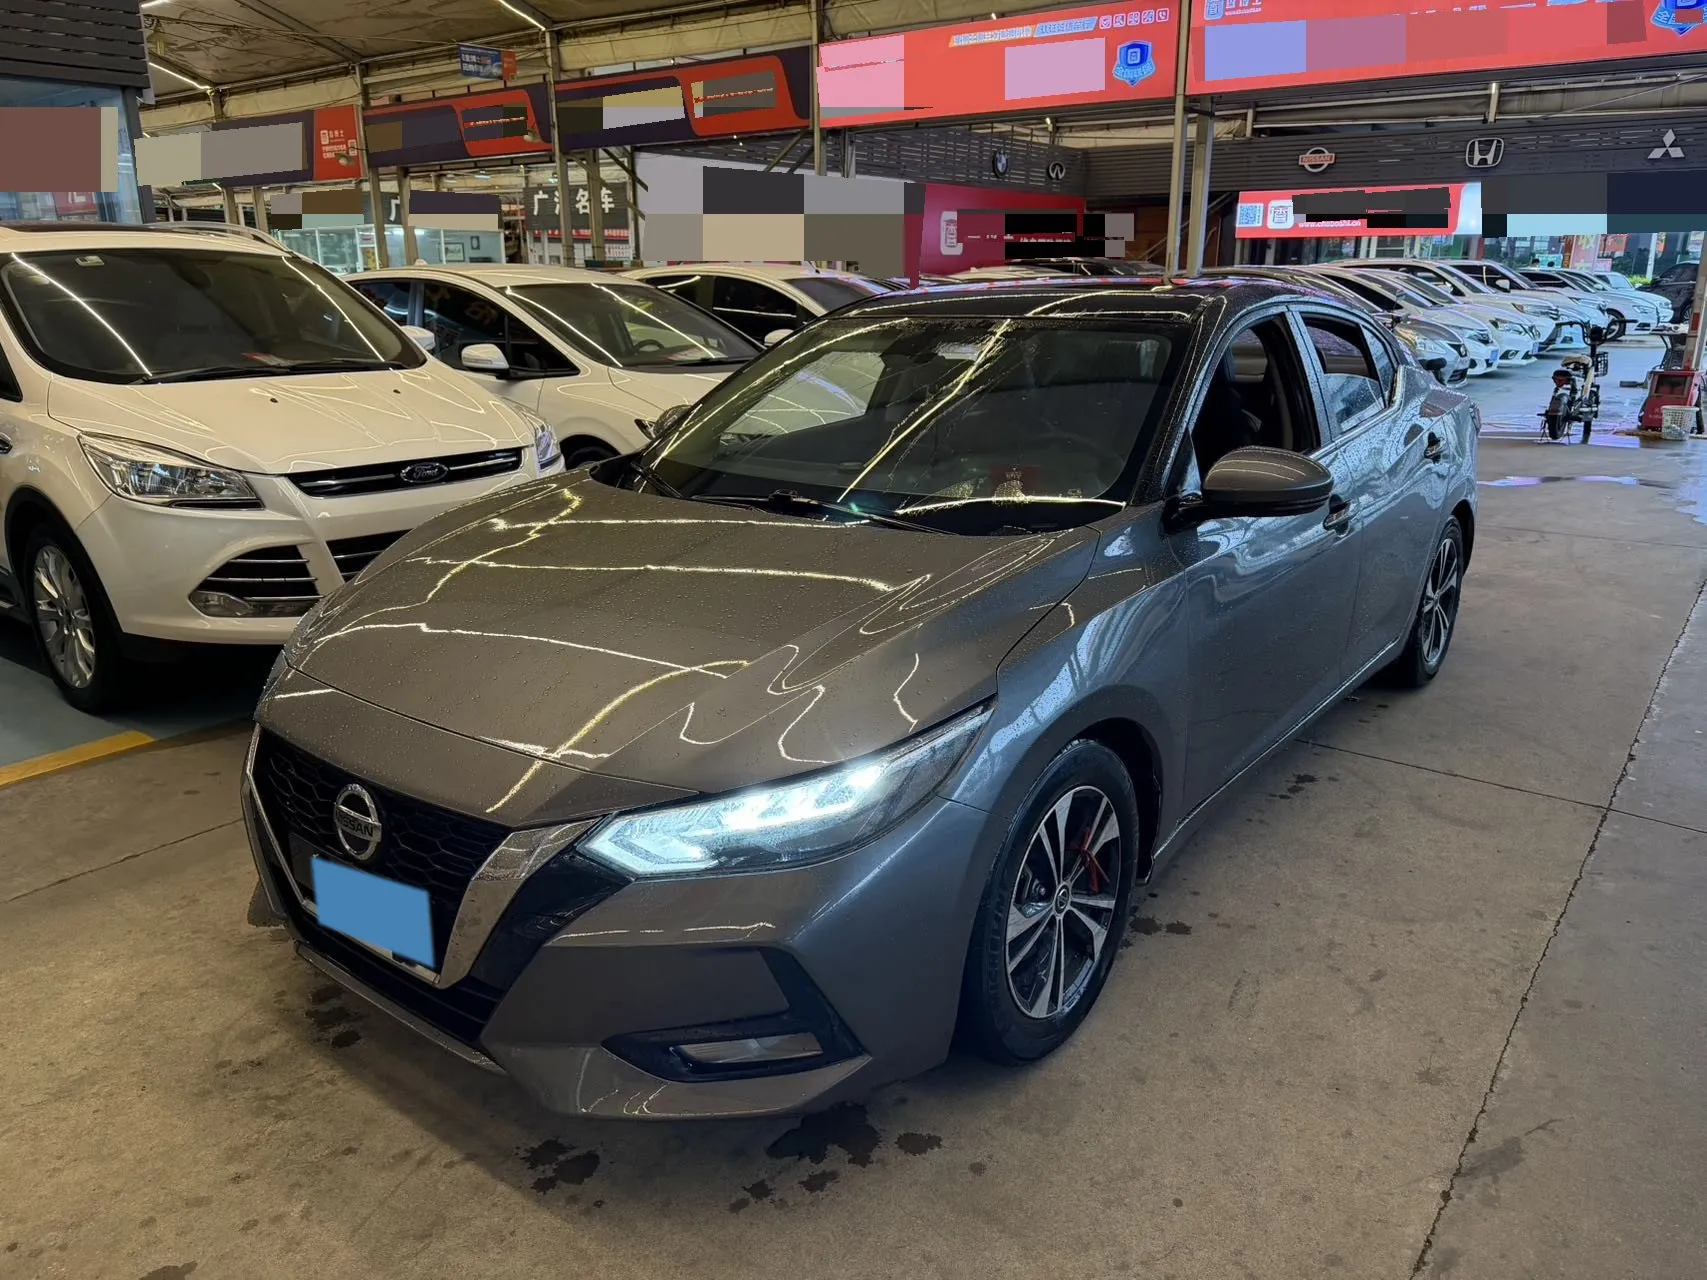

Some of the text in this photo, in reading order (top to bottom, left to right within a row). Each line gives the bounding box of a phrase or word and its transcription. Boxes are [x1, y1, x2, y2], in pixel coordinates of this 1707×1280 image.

[533, 187, 615, 216] 广名车
[335, 809, 374, 838] NISSAN
